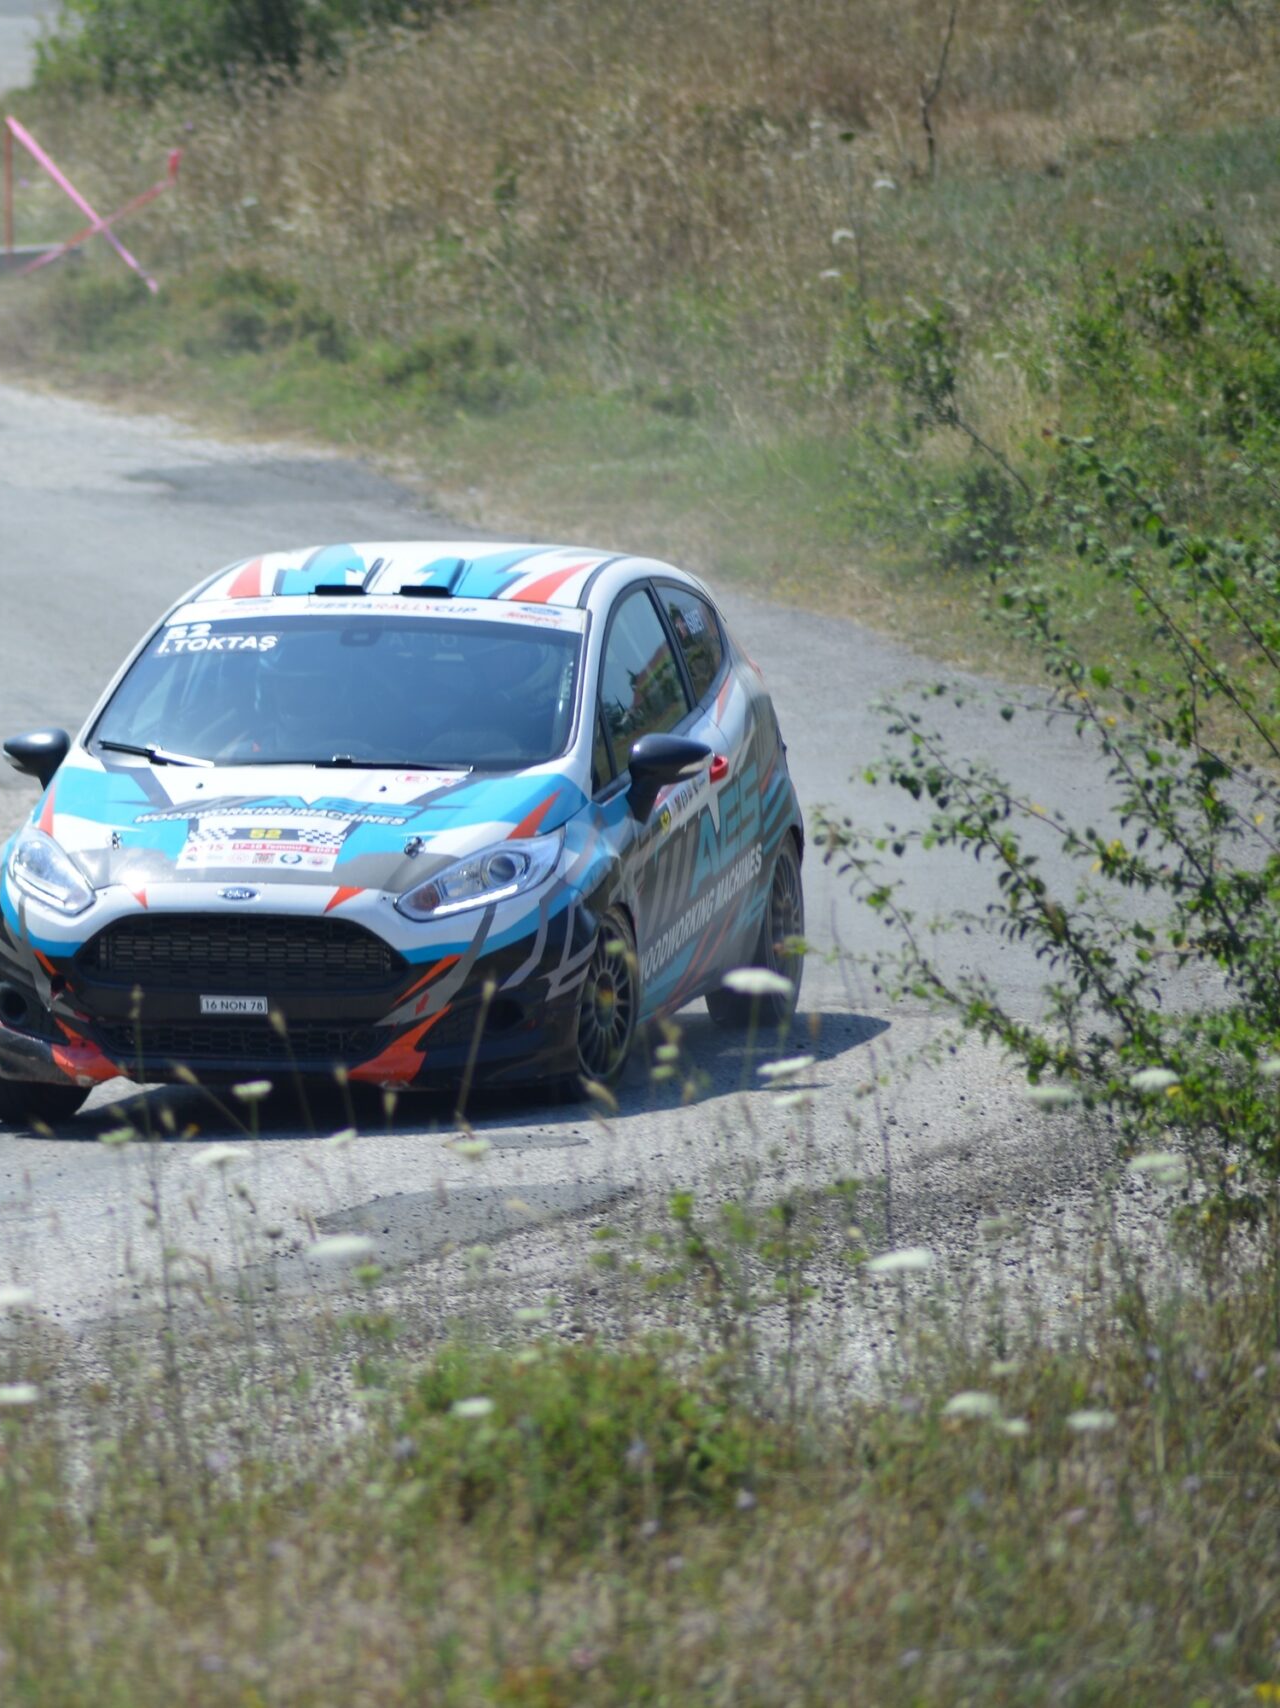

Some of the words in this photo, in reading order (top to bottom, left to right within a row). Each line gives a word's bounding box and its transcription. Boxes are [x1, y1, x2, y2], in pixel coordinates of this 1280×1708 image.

[249, 829, 281, 840] 52
[205, 1001, 218, 1009] 16
[221, 1001, 247, 1010] NON
[250, 1001, 263, 1011] 78
